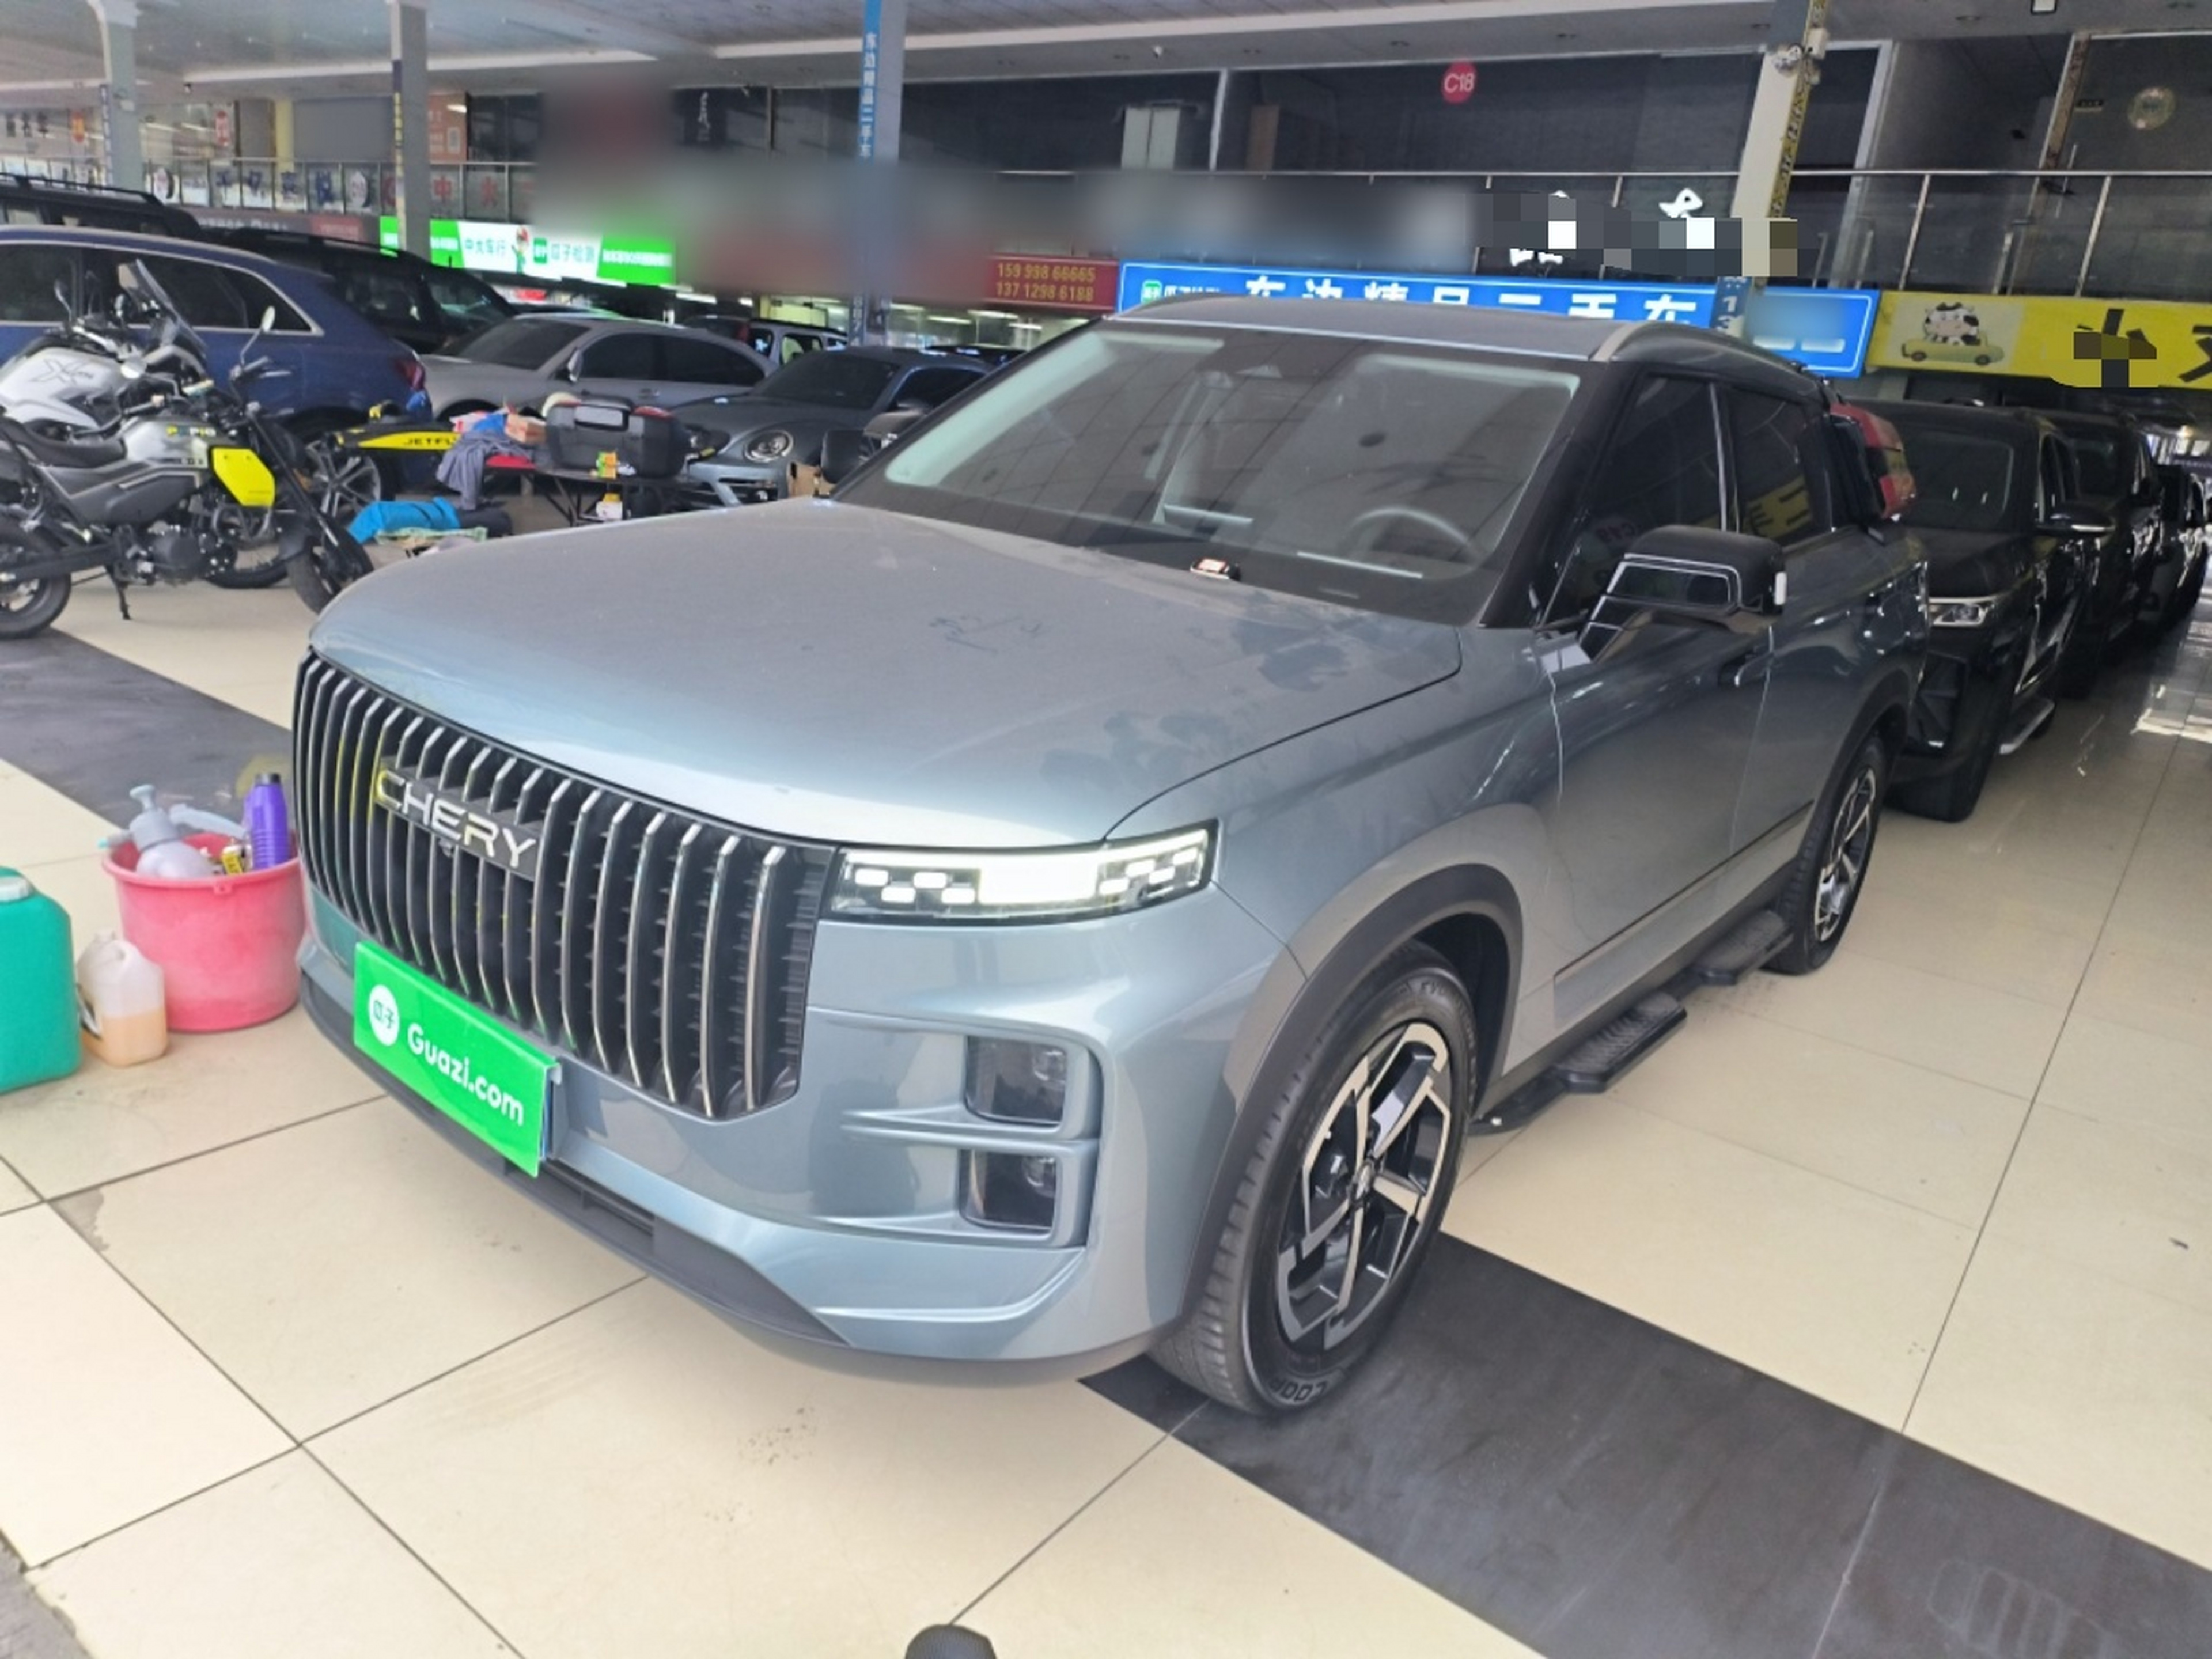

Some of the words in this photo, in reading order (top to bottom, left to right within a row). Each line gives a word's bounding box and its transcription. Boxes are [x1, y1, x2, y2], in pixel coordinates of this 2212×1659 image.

[1444, 73, 1475, 93] C18
[996, 281, 1020, 297] 137
[376, 769, 536, 868] CHERY
[407, 1022, 524, 1126] Guazi.com
